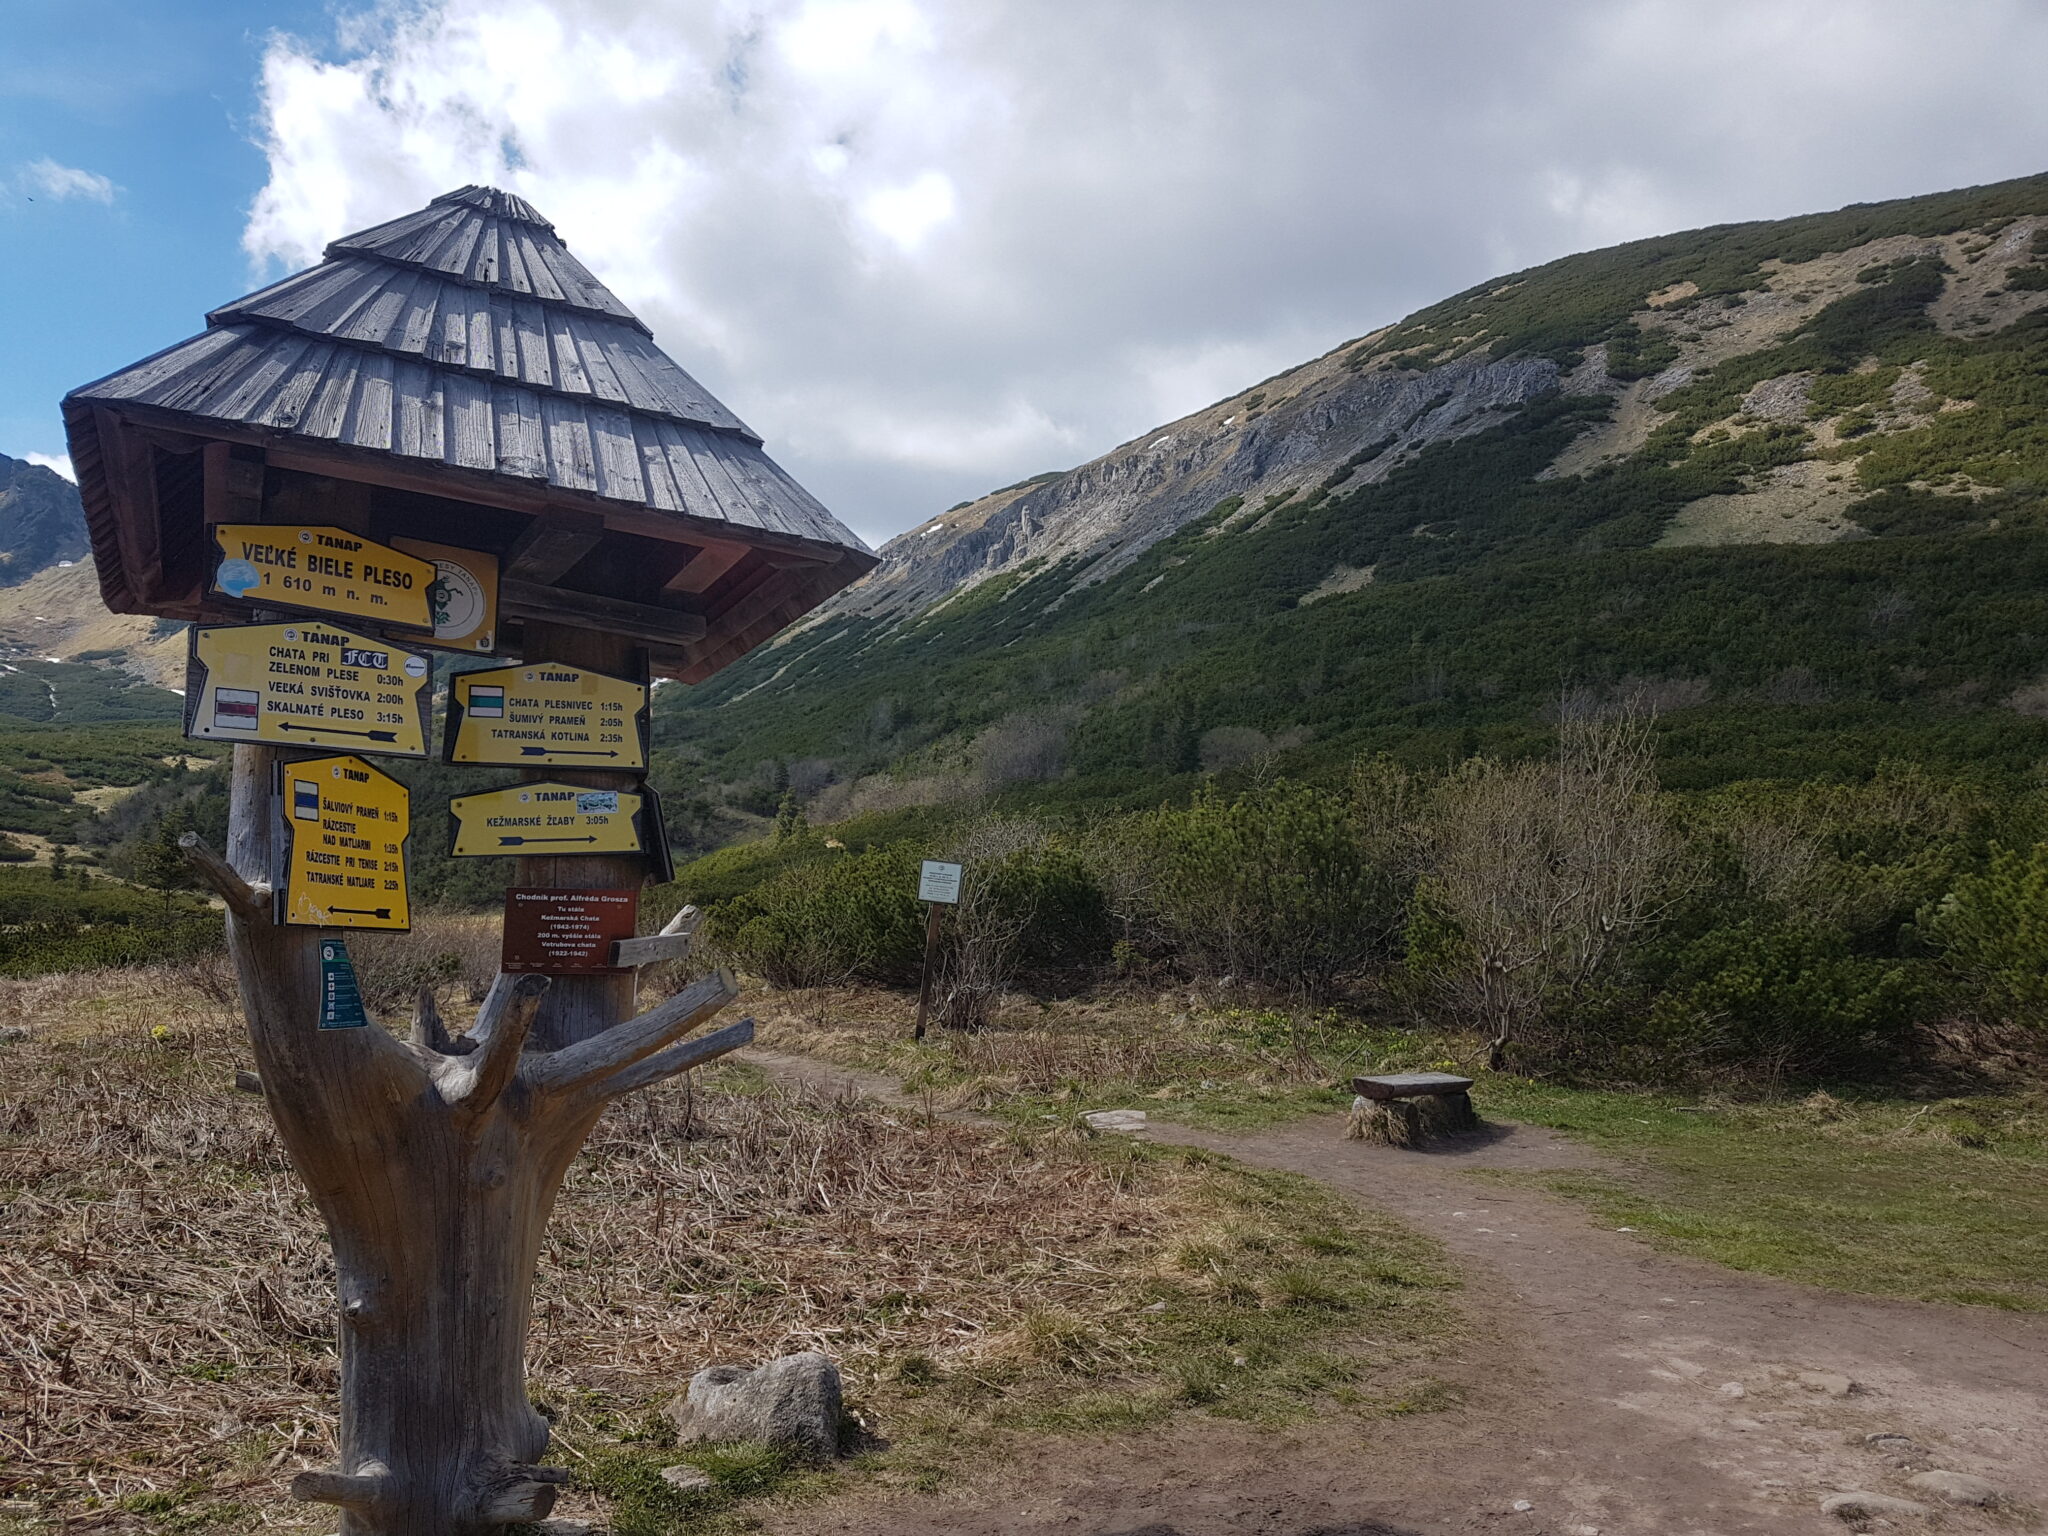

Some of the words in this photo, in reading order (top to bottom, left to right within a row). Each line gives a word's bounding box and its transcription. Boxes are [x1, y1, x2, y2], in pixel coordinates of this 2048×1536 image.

[316, 534, 363, 552] TANAP
[241, 541, 297, 569] VEĽKÉ
[307, 556, 354, 579] BIELE
[364, 565, 413, 590] PLESO
[322, 584, 336, 596] m
[347, 590, 360, 600] n.
[370, 593, 388, 606] m.
[301, 631, 350, 647] TANAP
[269, 646, 306, 662] CHATA
[312, 650, 330, 663] PRI
[269, 661, 320, 677] ZELENOM
[326, 669, 359, 682] PLESE
[377, 674, 404, 687] 0:30h
[539, 671, 580, 683] TANAP
[268, 680, 304, 695] VEĽKÁ
[310, 682, 371, 702] SVIŠŤOVKA
[377, 693, 404, 705] 2:00h
[267, 700, 324, 717] SKALNATÉ
[330, 706, 364, 721] PLESO
[376, 712, 403, 724] 3:15h
[509, 698, 539, 708] CHATA
[544, 699, 593, 711] PLESNIVEC
[600, 702, 623, 712] 1:15h
[509, 711, 544, 724] ŠUMIVÝ
[549, 714, 586, 725] PRAMEŇ
[600, 718, 623, 727] 2:05h
[491, 729, 546, 740] TATRANSKÁ
[551, 731, 590, 742] KOTLINA
[600, 733, 623, 743] 2:35h
[343, 768, 370, 783] TANAP
[534, 791, 575, 802] TANAP
[323, 797, 353, 815] ŠALVIOVÝ
[356, 805, 379, 819] PRAMEŇ
[384, 811, 398, 822] 1:15h
[323, 818, 356, 834] RÁZCESTIE
[486, 814, 541, 827] KEŽMARSKÉ
[546, 815, 575, 826] ŽĽABY
[586, 816, 609, 825] 3:05h
[323, 834, 336, 846] NAD
[339, 836, 371, 850] MATLIARMI
[384, 843, 398, 854] 1:35h
[306, 849, 340, 866] RÁZCESTIE
[345, 856, 355, 868] PRI
[358, 858, 378, 870] TENISE
[384, 861, 398, 872] 2:15h
[306, 871, 343, 886] TATRANSKÉ
[347, 876, 375, 888] MATLIARE
[384, 880, 398, 890] 2:25h
